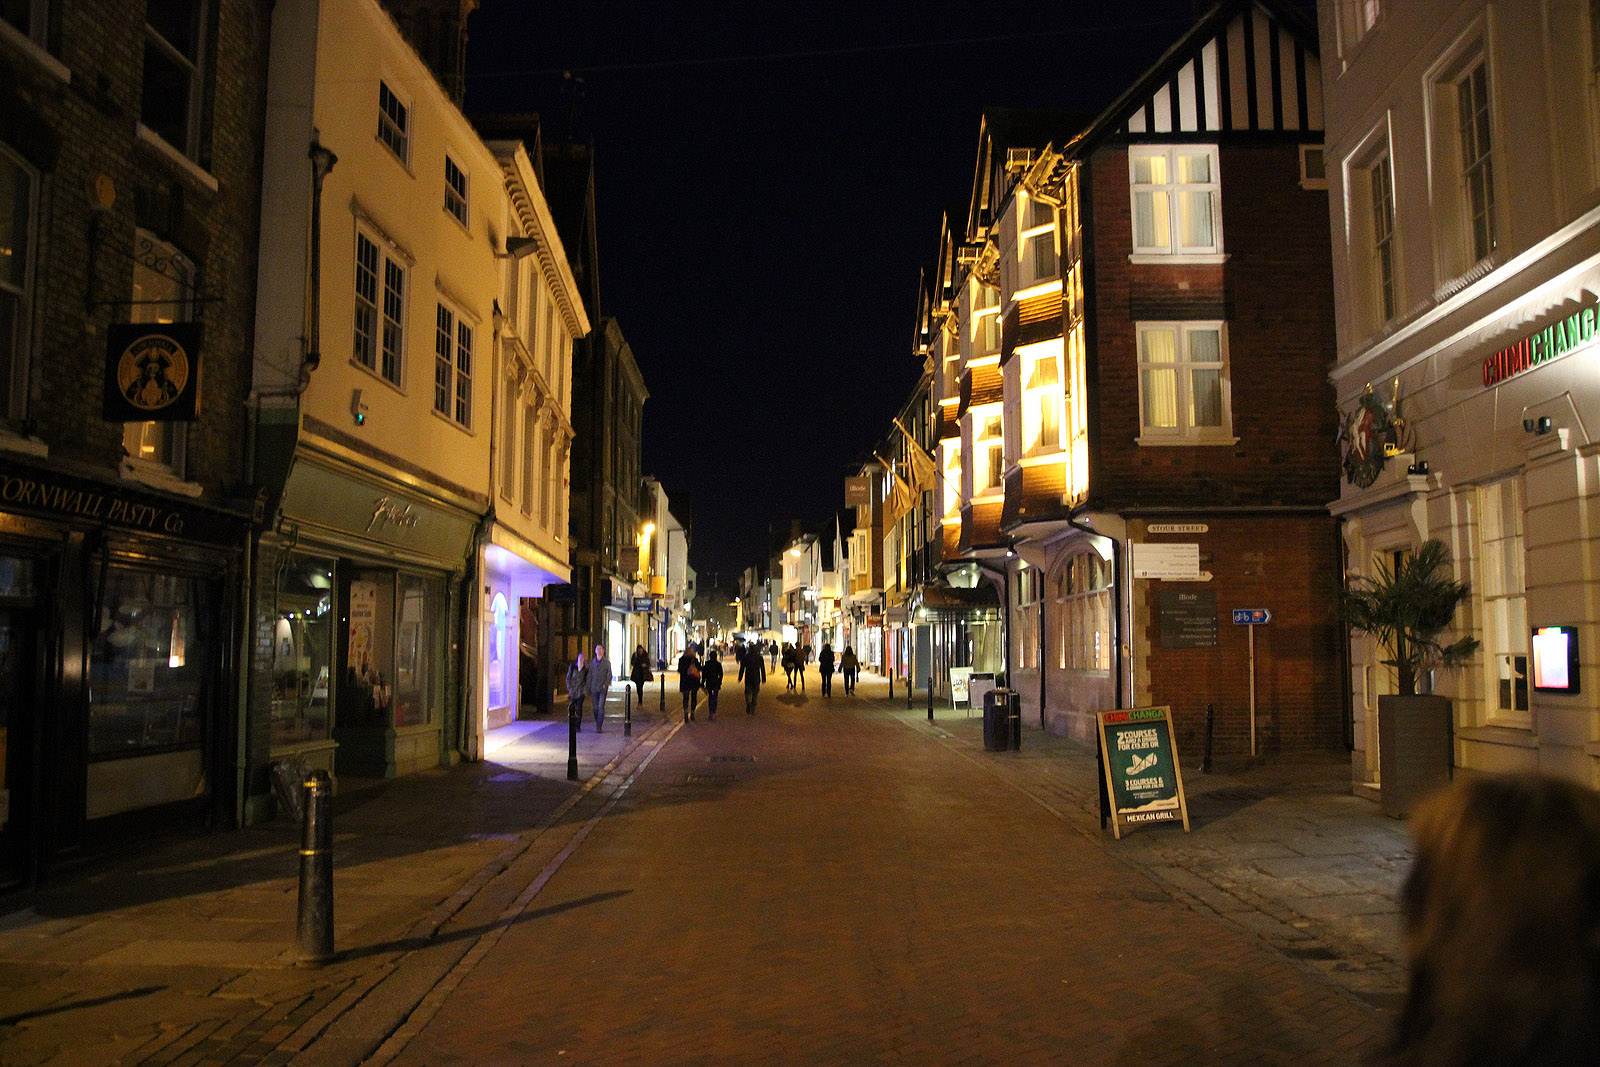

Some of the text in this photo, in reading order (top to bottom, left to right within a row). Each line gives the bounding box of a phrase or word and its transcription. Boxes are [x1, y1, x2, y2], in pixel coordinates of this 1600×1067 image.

[1483, 303, 1600, 388] CHIMICHANG
[107, 498, 160, 526] PASTY
[1105, 709, 1165, 721] CHIMICHANGA
[1116, 729, 1158, 745] 2 COURSES
[1117, 743, 1131, 751] FOR
[1150, 740, 1160, 748] OR
[1129, 777, 1158, 787] COURSES
[1126, 811, 1174, 823] MEXICAN GRILL
